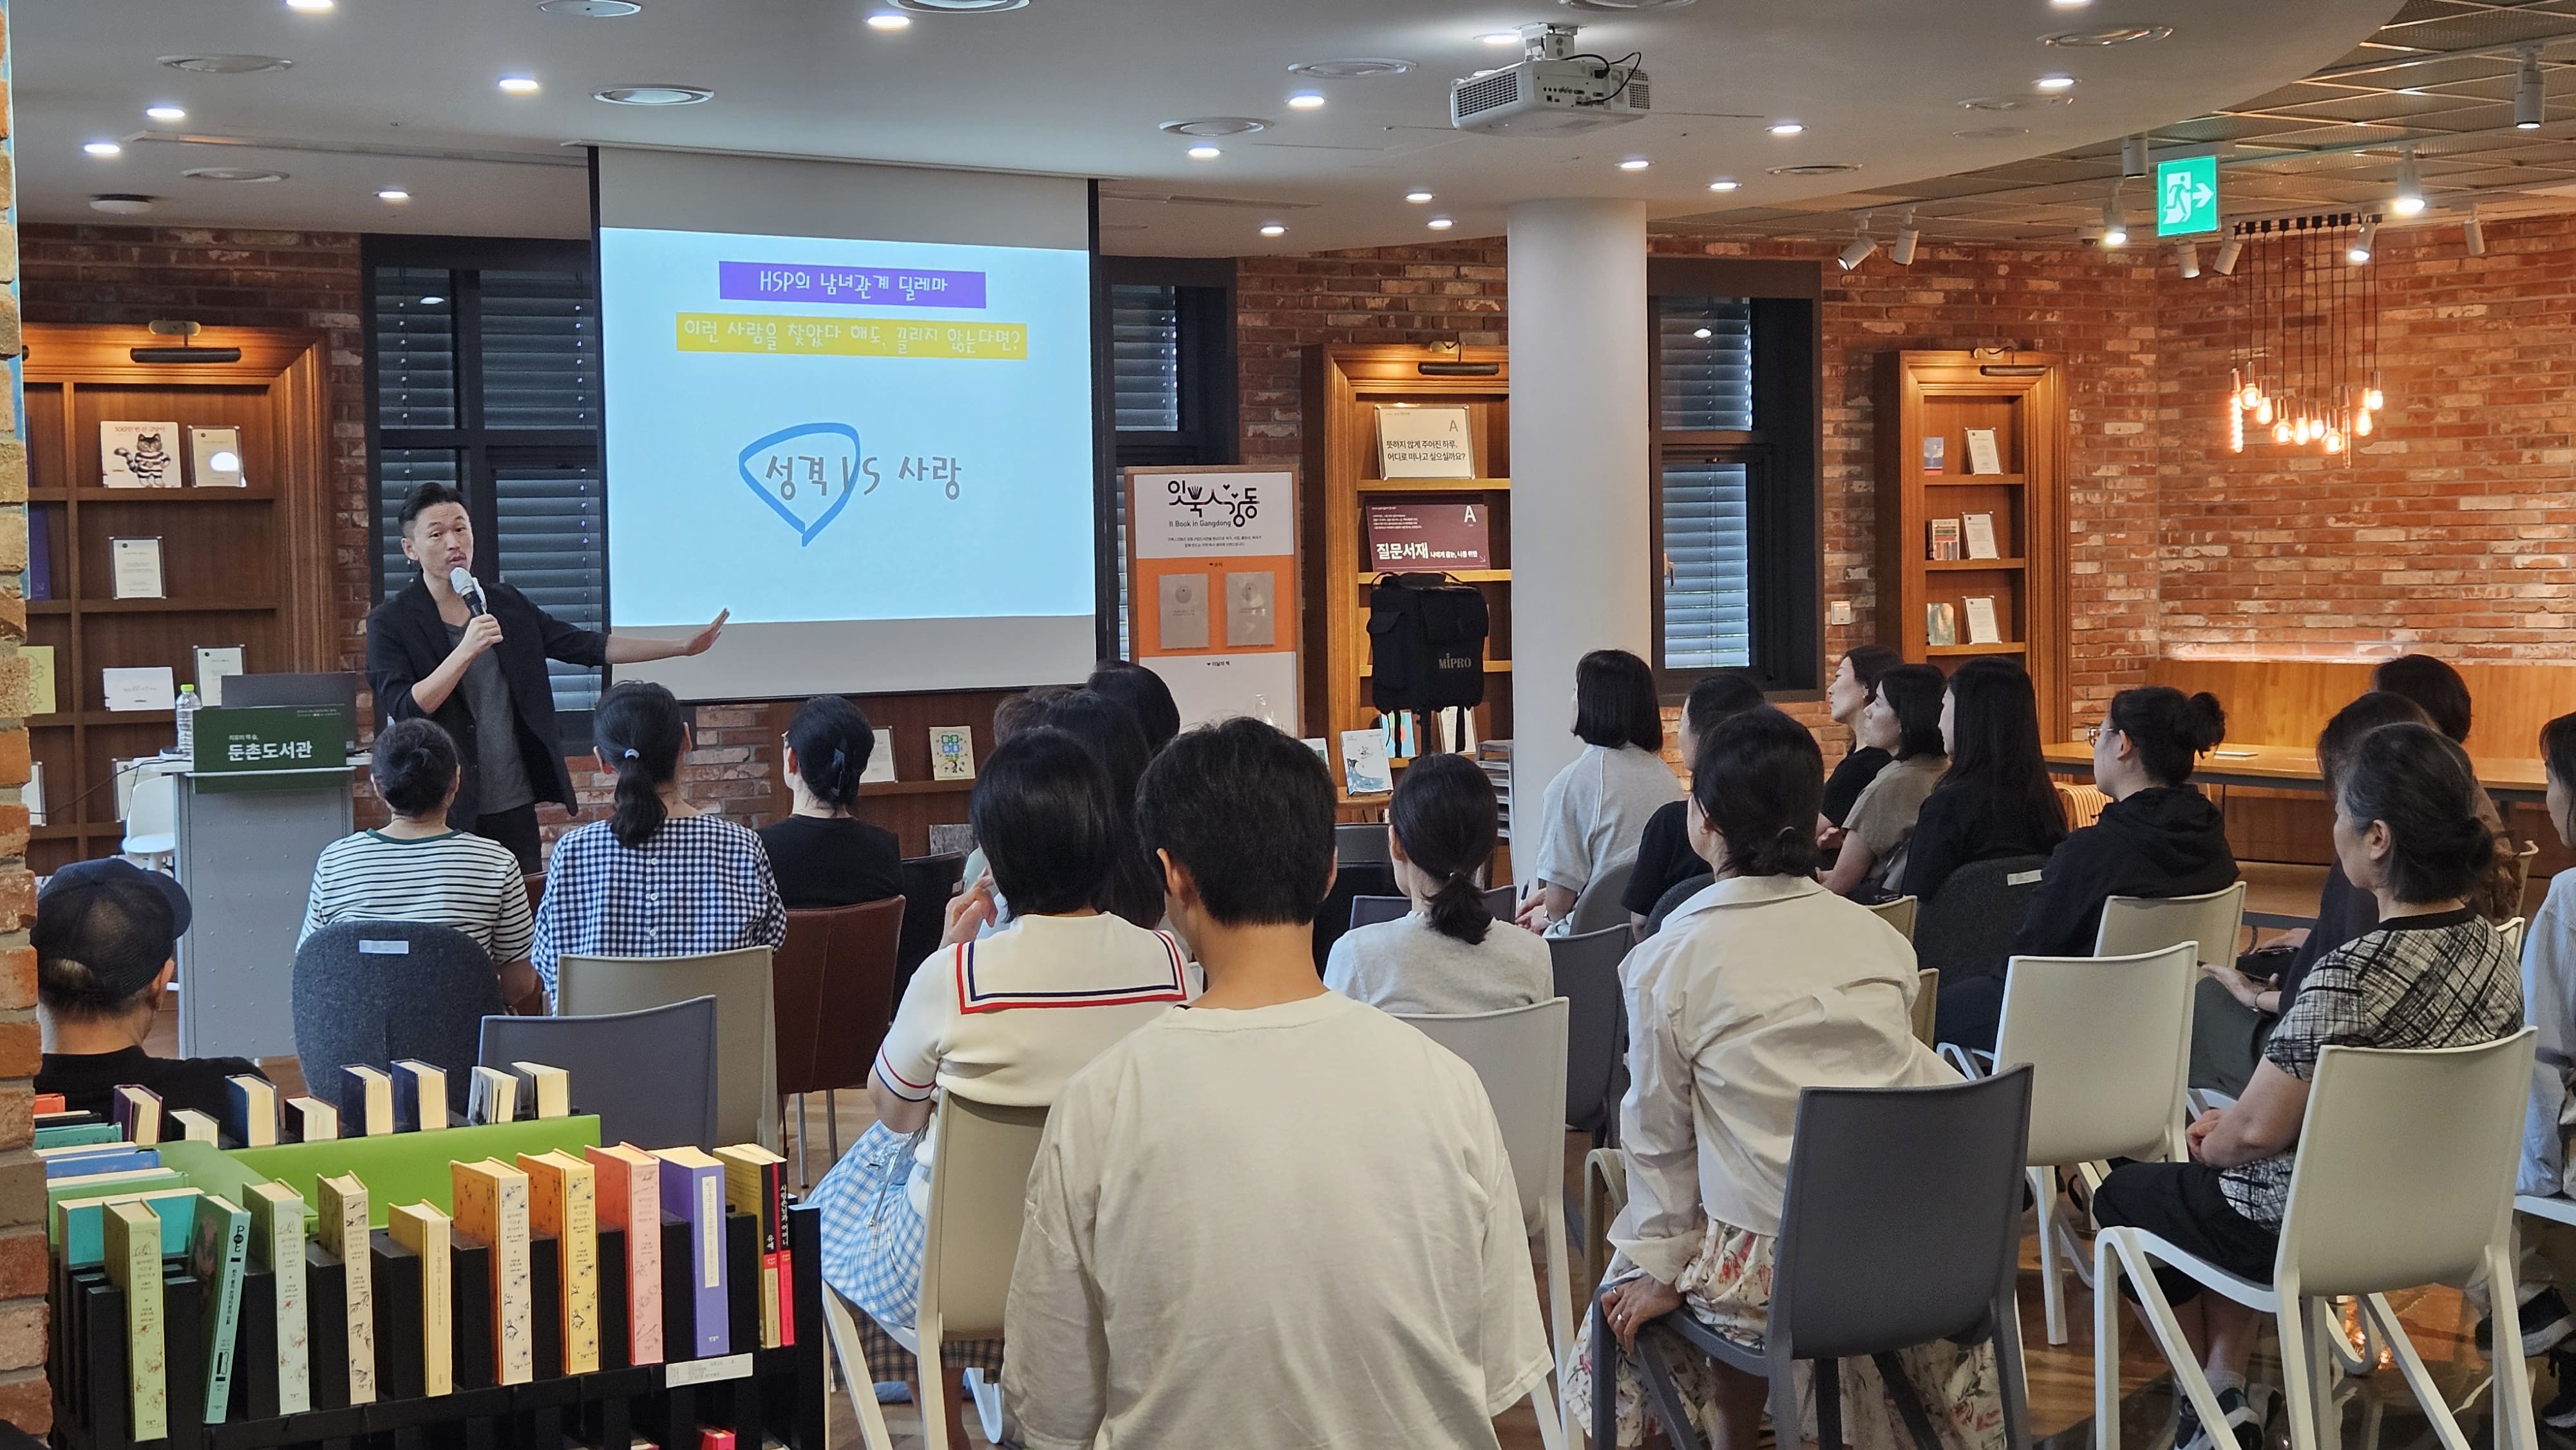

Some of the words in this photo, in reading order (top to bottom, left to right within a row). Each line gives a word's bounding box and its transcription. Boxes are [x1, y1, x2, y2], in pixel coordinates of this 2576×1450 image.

[759, 270, 810, 292] HSP의
[820, 272, 889, 299] 남녀관계
[899, 276, 949, 301] 딜레마
[685, 319, 718, 343] 이런
[728, 322, 777, 351] 사람을
[788, 323, 841, 348] 찾았다
[896, 326, 938, 354] 끌리지
[947, 328, 1021, 353] 않는다면?
[1449, 420, 1459, 432] A
[1387, 440, 1406, 449] 뜻하지
[1422, 440, 1441, 449] 주어진
[1387, 453, 1408, 461] 어디로
[1408, 452, 1428, 461] 떠나고
[765, 455, 827, 500] 성격
[898, 456, 962, 500] 사랑
[1464, 505, 1477, 523] A
[1200, 520, 1231, 528] Gangdong
[1376, 542, 1428, 560] 질문서재
[228, 740, 312, 762] 둔촌도서관
